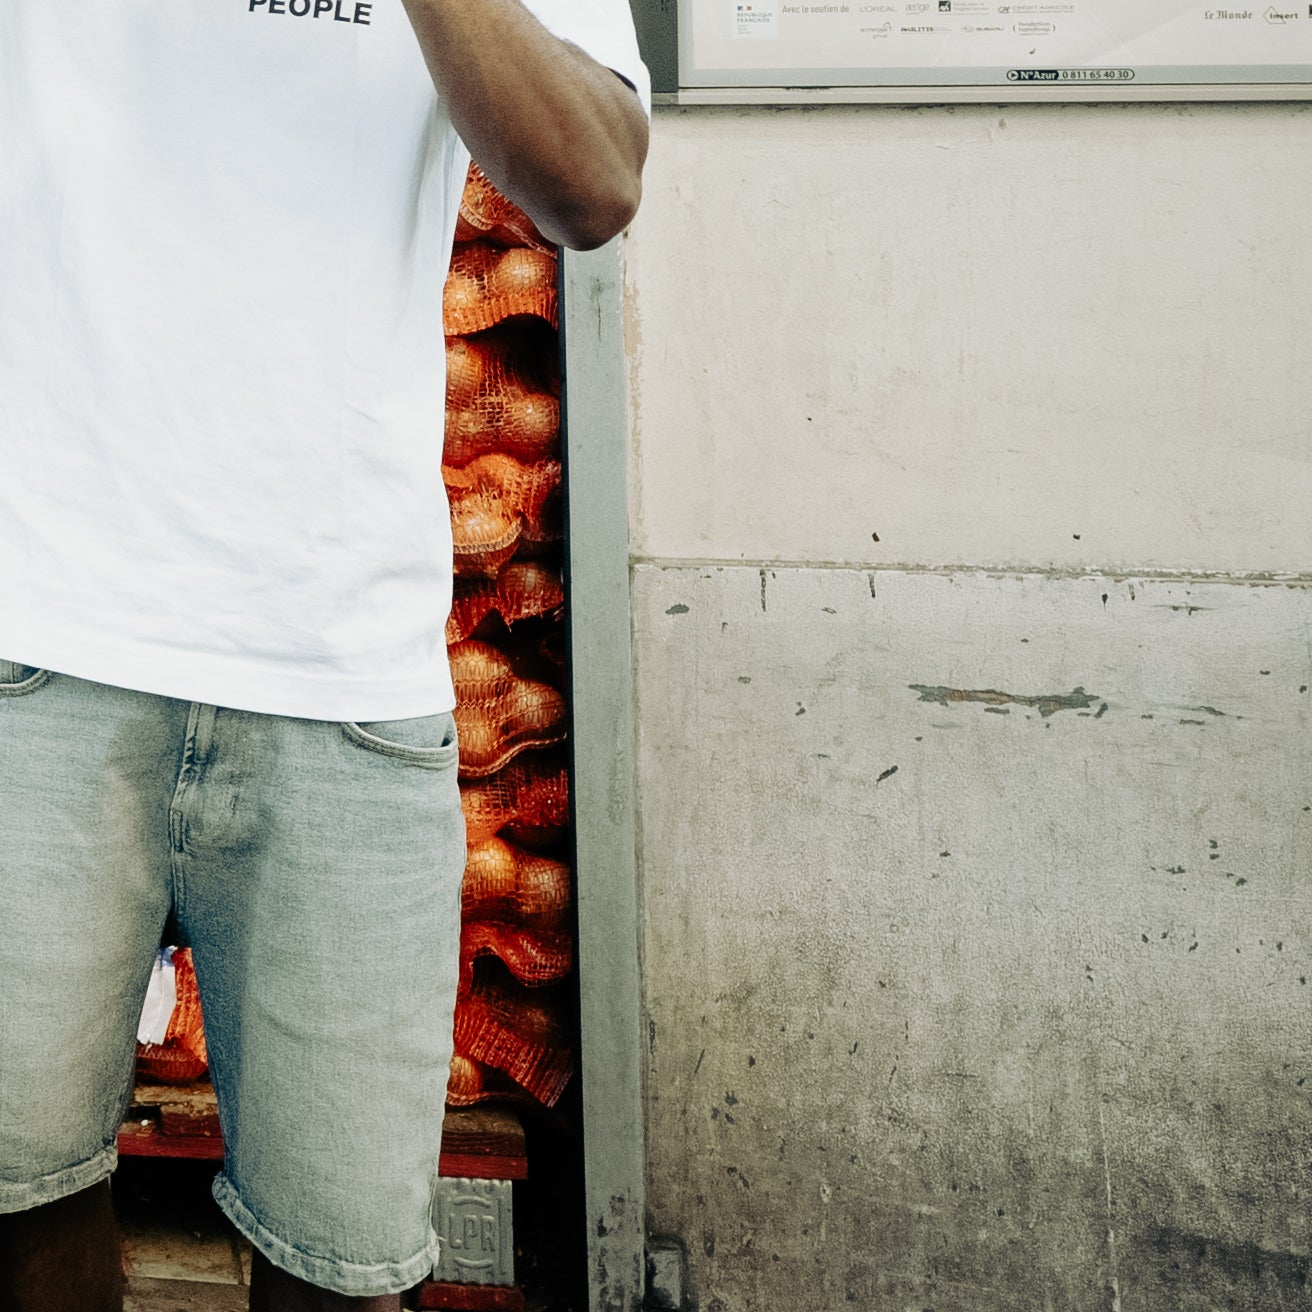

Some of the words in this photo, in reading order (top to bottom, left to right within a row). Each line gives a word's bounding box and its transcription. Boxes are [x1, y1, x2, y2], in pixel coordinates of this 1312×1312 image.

[782, 5, 801, 14] Avec
[802, 5, 809, 13] le
[811, 5, 838, 14] soutien
[840, 4, 850, 13] de
[1216, 10, 1253, 20] Monde
[1062, 70, 1068, 78] 0
[1090, 70, 1101, 78] 65
[1103, 70, 1115, 78] 40
[1117, 70, 1129, 78] 30
